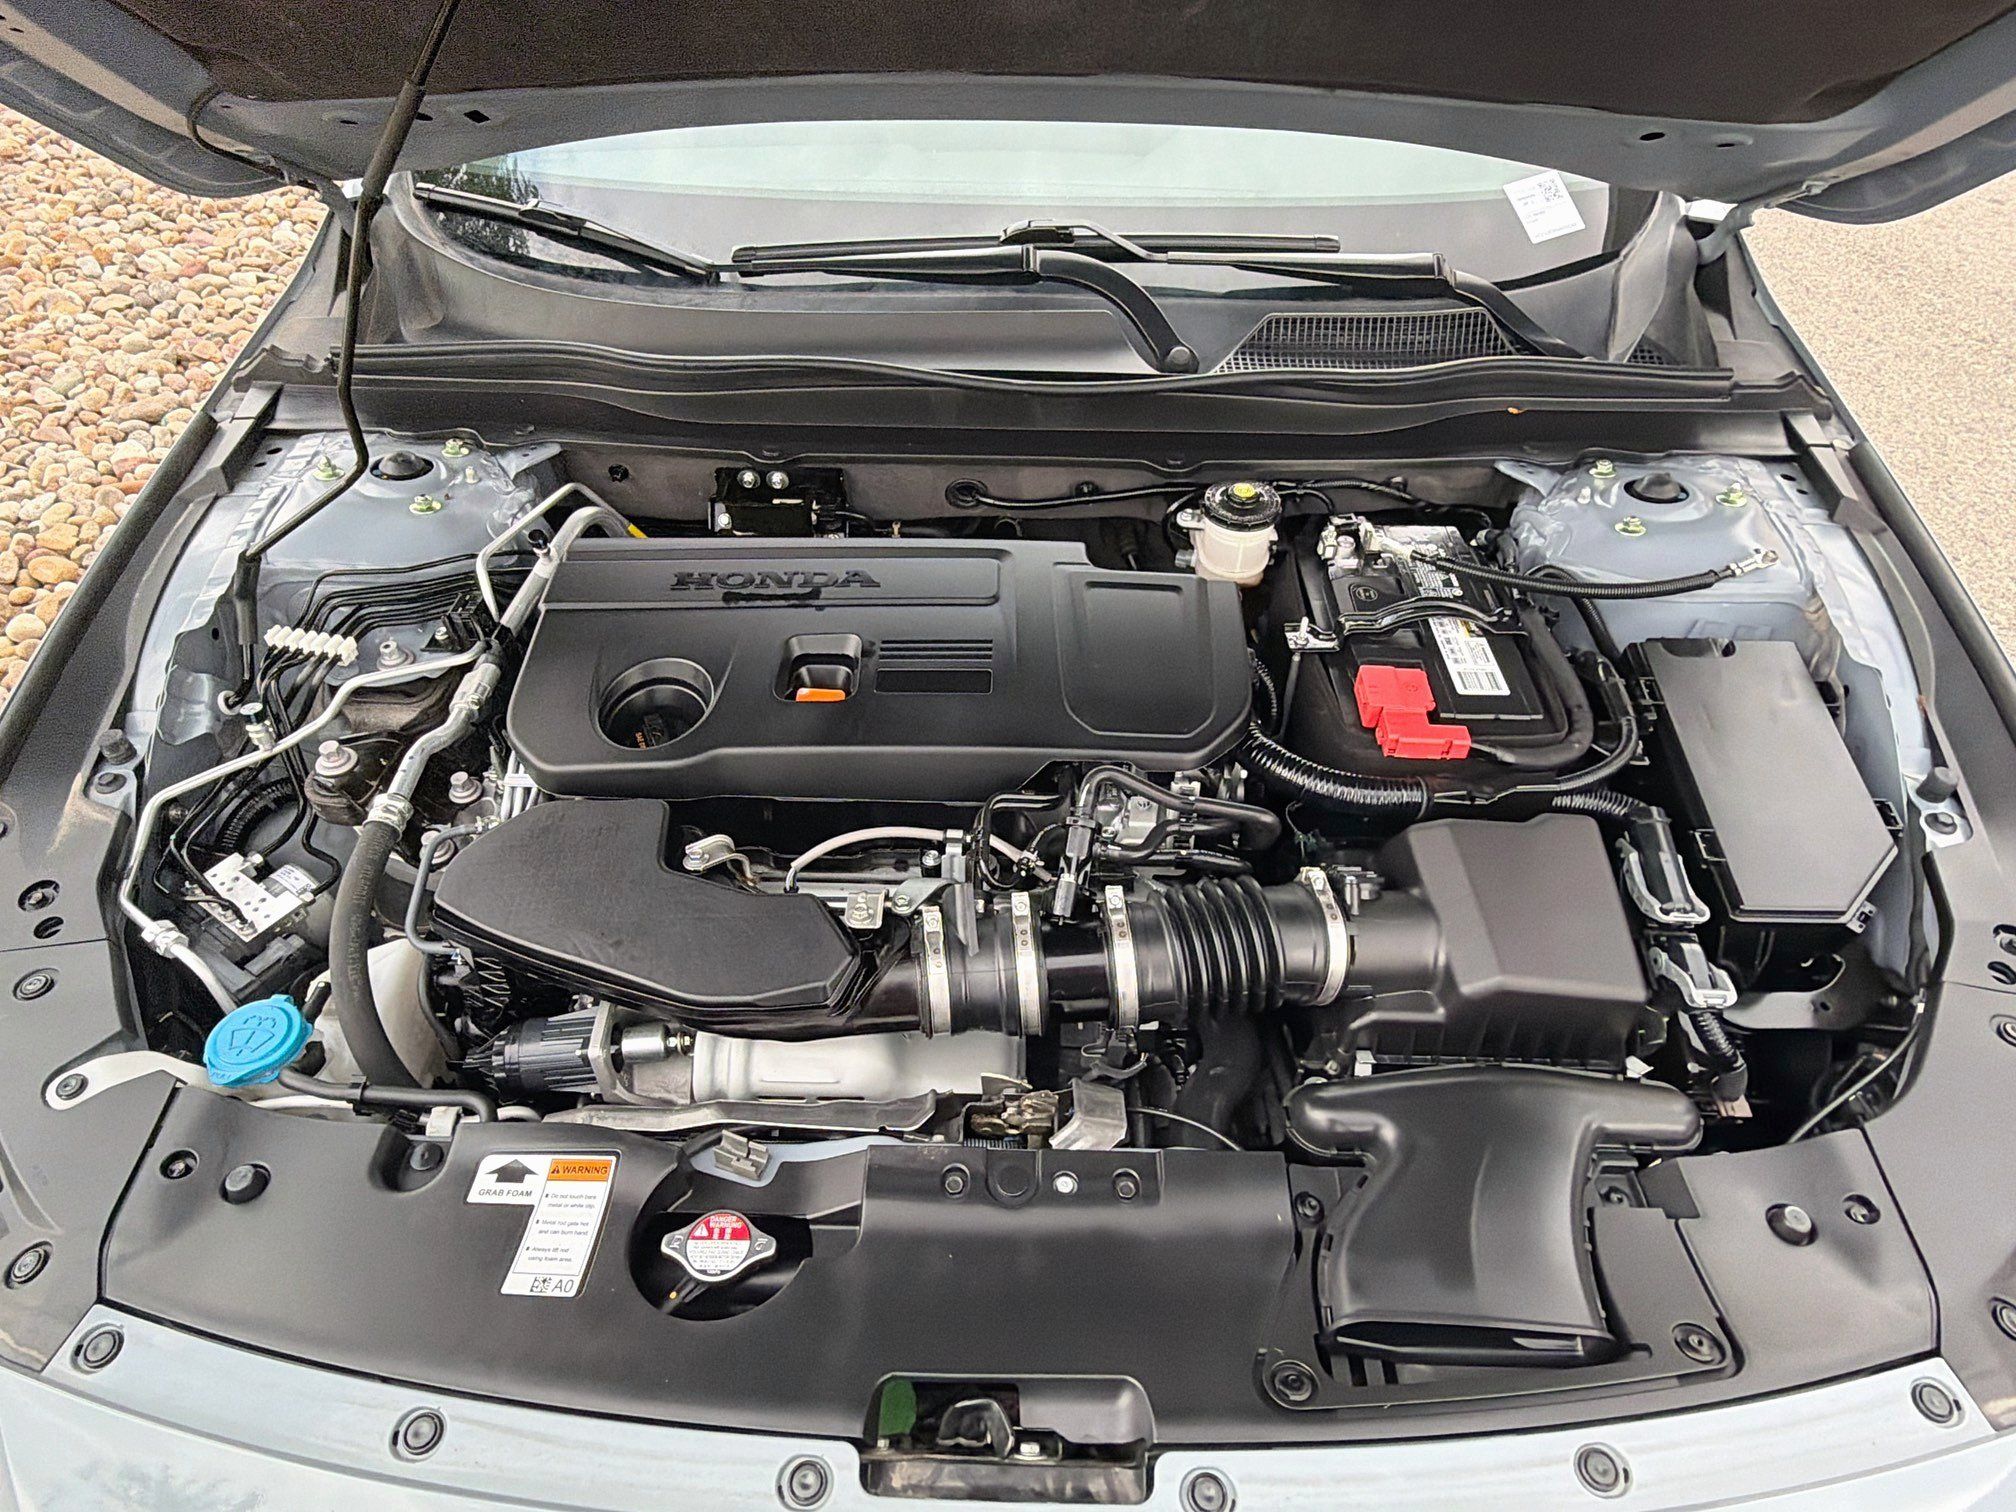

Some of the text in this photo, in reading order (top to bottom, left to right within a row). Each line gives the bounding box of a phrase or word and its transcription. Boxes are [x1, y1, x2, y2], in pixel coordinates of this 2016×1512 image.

[670, 569, 881, 591] HONDA
[562, 1165, 608, 1175] WARNING
[478, 1188, 533, 1197] GRAB FOAM
[709, 1214, 738, 1222] DANGER
[709, 1221, 742, 1229] WARNING
[551, 1278, 575, 1293] A0
